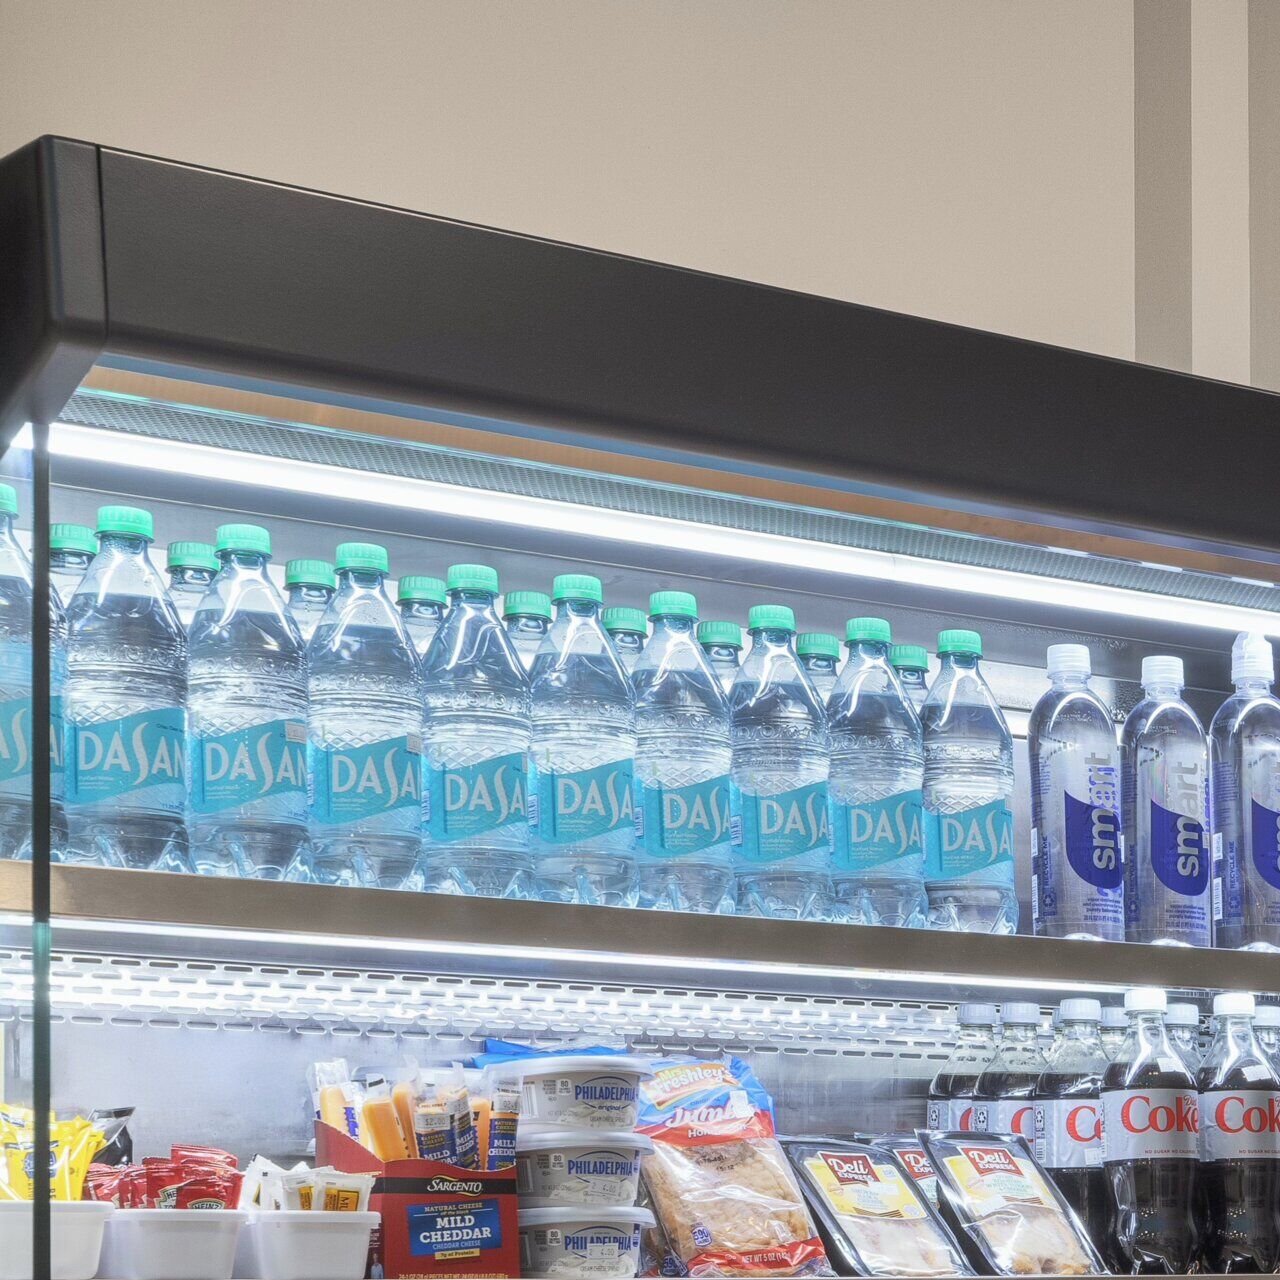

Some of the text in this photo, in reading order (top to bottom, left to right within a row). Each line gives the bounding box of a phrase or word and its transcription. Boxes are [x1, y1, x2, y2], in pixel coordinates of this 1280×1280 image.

[1084, 754, 1115, 870] smart
[1172, 762, 1199, 878] smart
[575, 1085, 636, 1102] PHILADELPHIA
[598, 1104, 622, 1112] original
[970, 1150, 1009, 1164] Deli
[568, 1160, 632, 1176] PHILADELPHIA
[828, 1158, 869, 1175] Deli
[427, 1179, 482, 1193] SARGENTO
[458, 1202, 483, 1210] CHEESE
[436, 1216, 475, 1228] MILD
[420, 1227, 491, 1243] CHEDDAR
[433, 1242, 460, 1250] CHEDDAR
